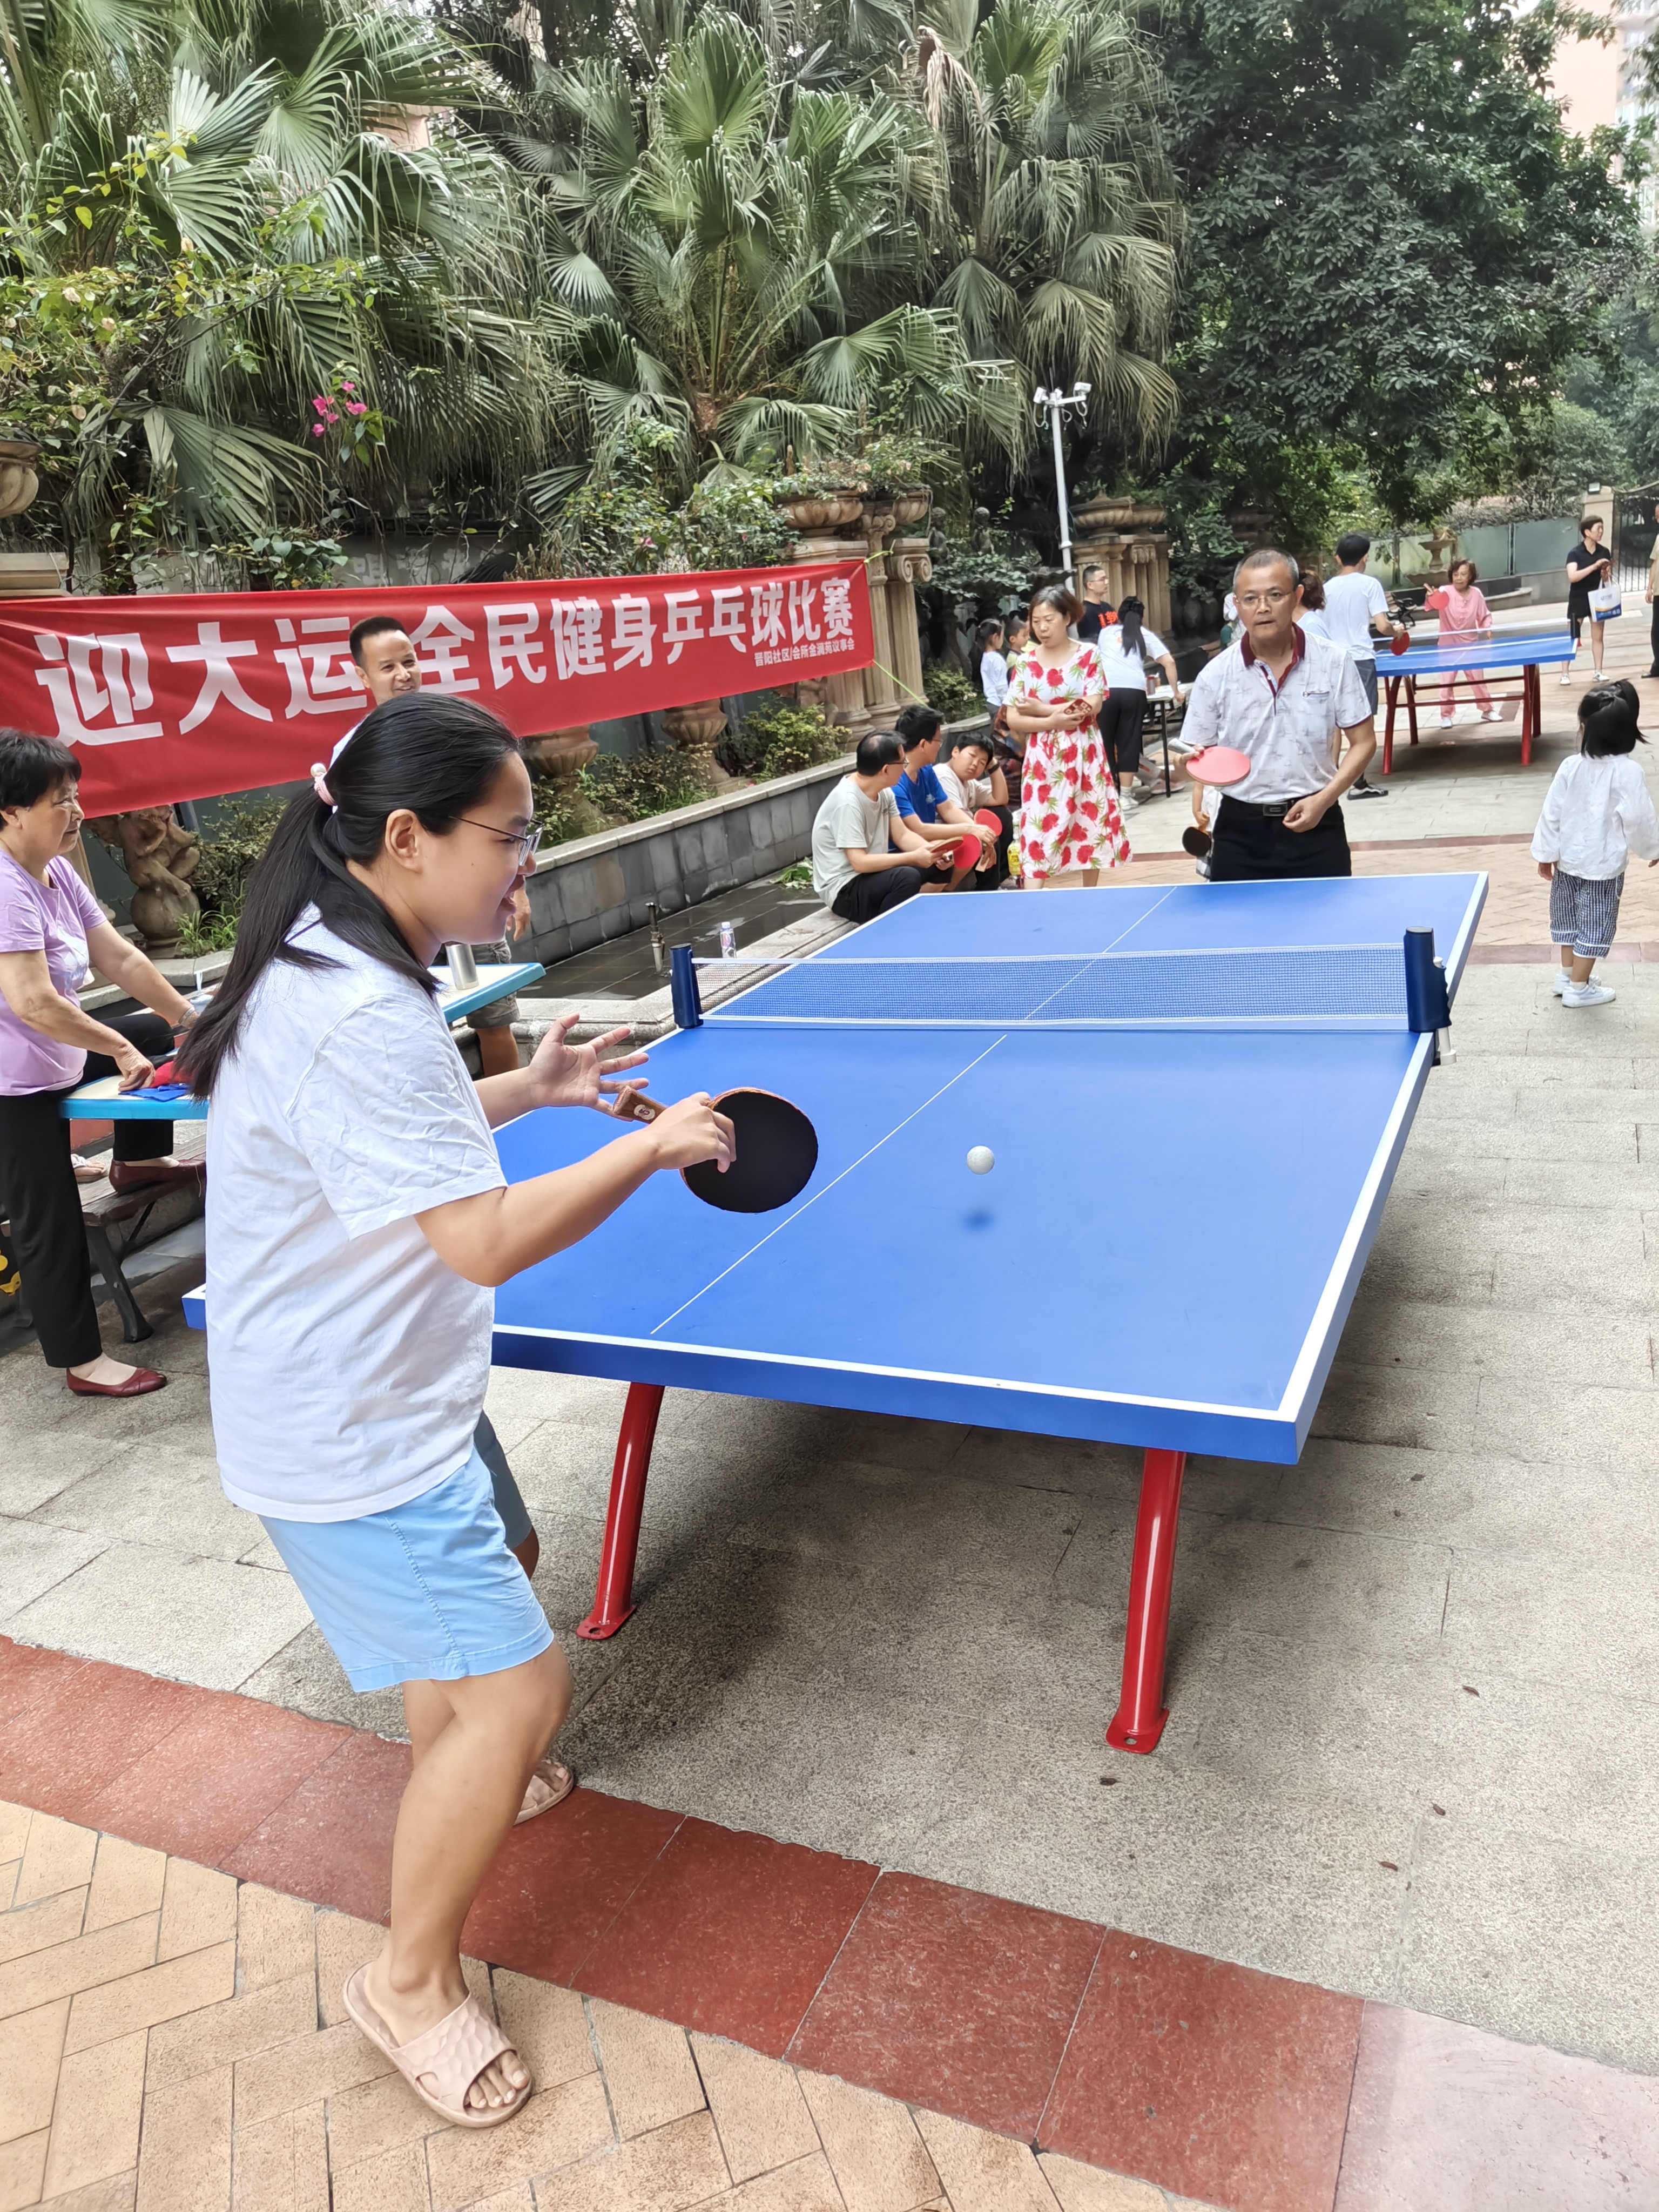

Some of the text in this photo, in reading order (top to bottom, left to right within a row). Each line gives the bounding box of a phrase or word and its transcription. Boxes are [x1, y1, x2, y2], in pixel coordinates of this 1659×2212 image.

[34, 577, 853, 747] 迎大运 全民健身乒乓球比赛
